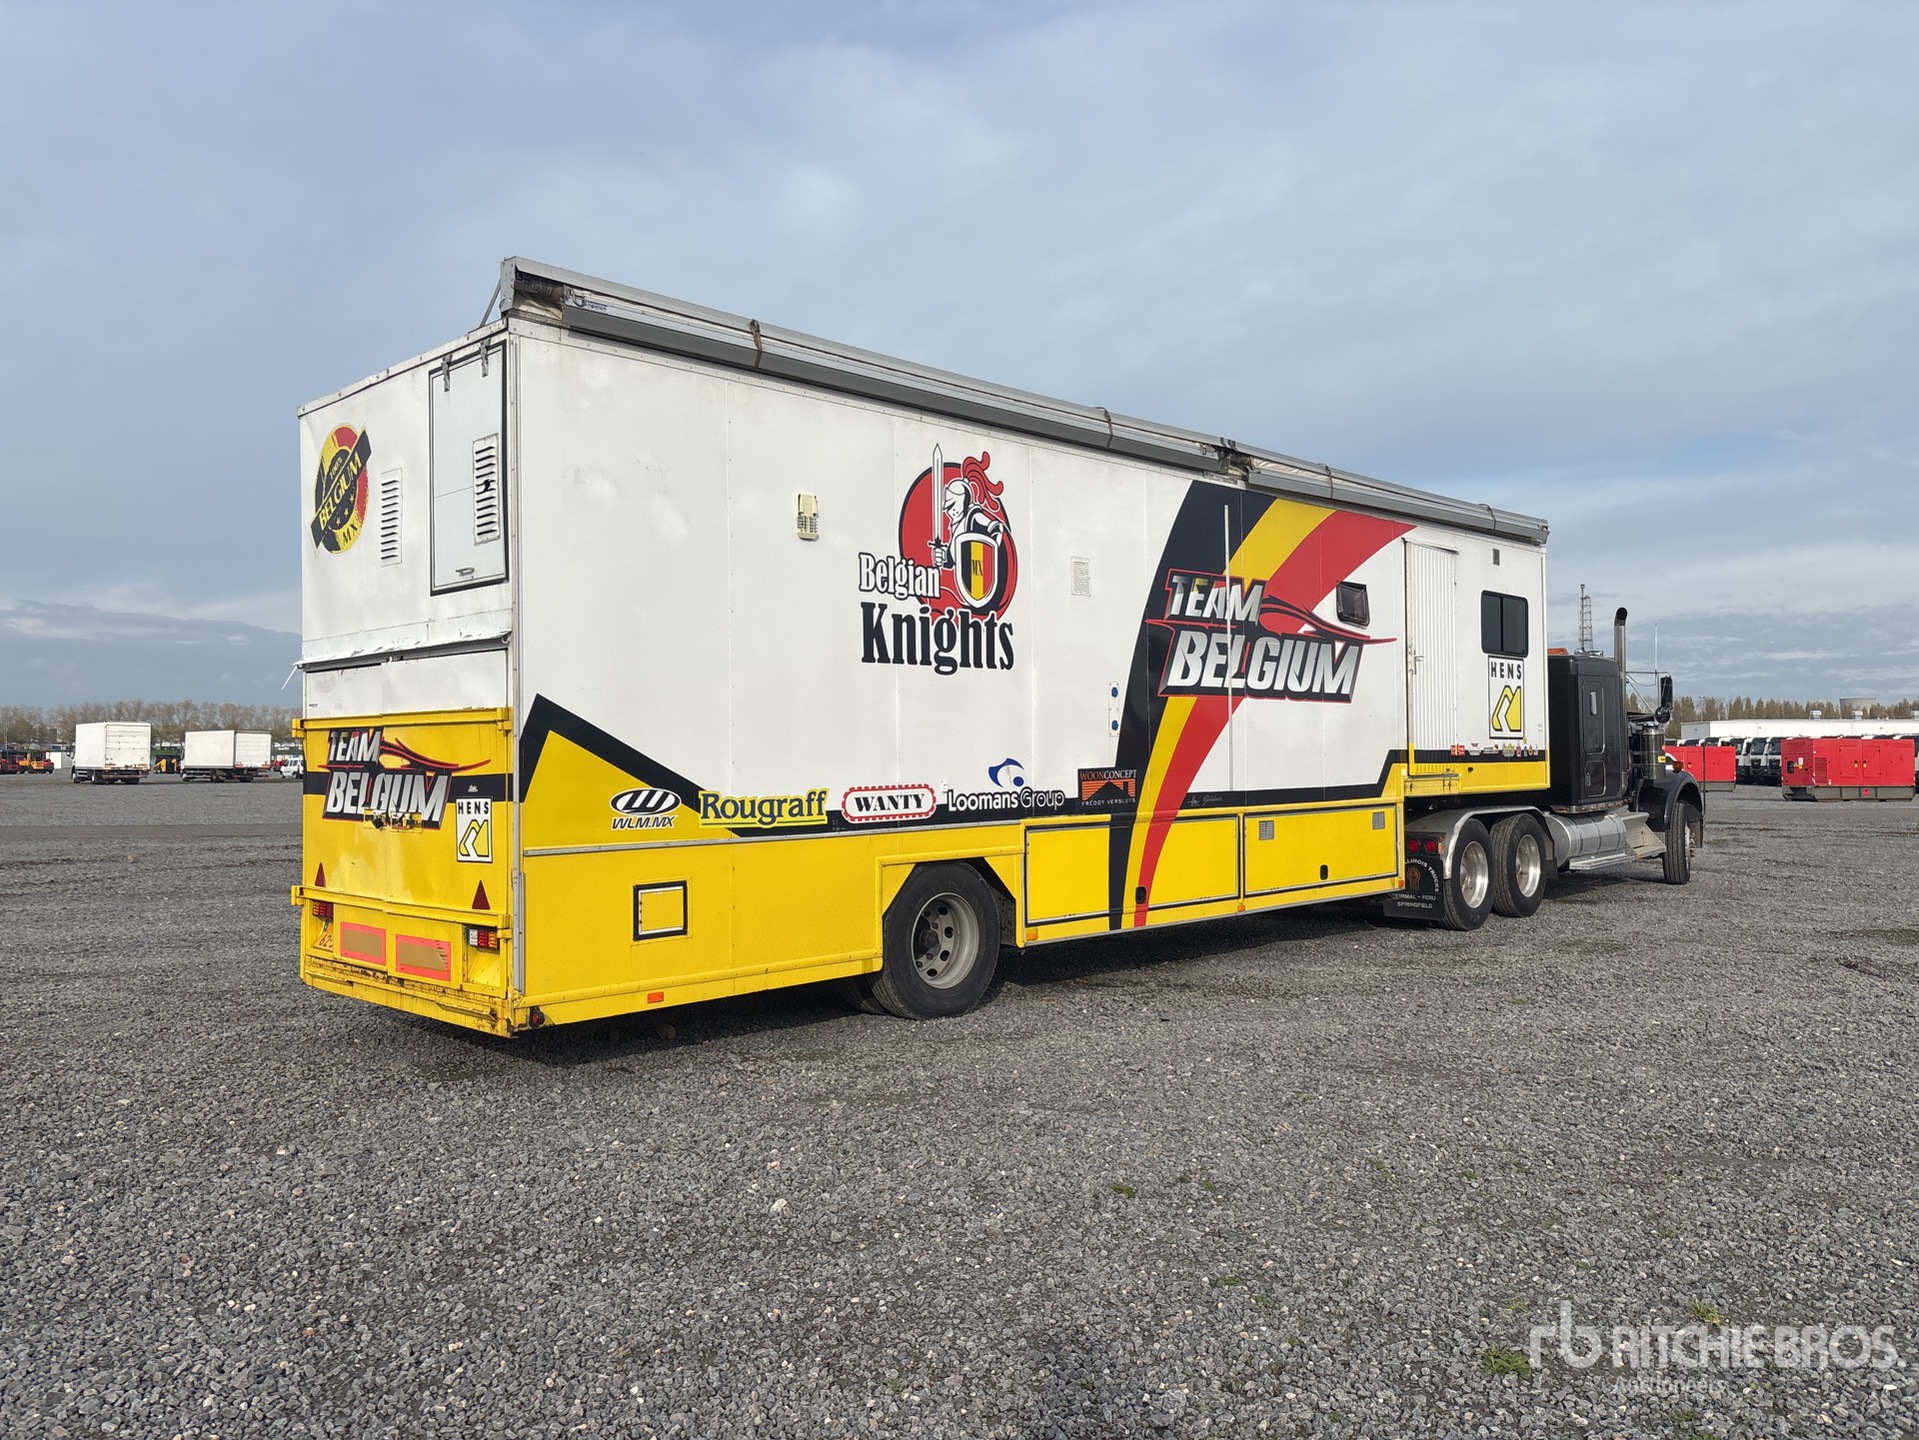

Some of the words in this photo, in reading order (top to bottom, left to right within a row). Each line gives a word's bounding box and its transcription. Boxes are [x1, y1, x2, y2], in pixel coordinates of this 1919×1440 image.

[319, 451, 362, 531] BELGIUM
[342, 519, 358, 546] MX
[859, 552, 940, 600] Belgian
[971, 559, 983, 577] MX
[1169, 575, 1264, 624] TEAM
[860, 602, 1014, 676] Knights
[1164, 630, 1360, 695] BELGIUM
[1490, 661, 1522, 680] HENS
[329, 731, 382, 763] TEAM
[325, 771, 449, 822] BELGIUM
[458, 801, 490, 815] HENS
[701, 790, 827, 825] Rougraff
[854, 793, 926, 812] WANTY
